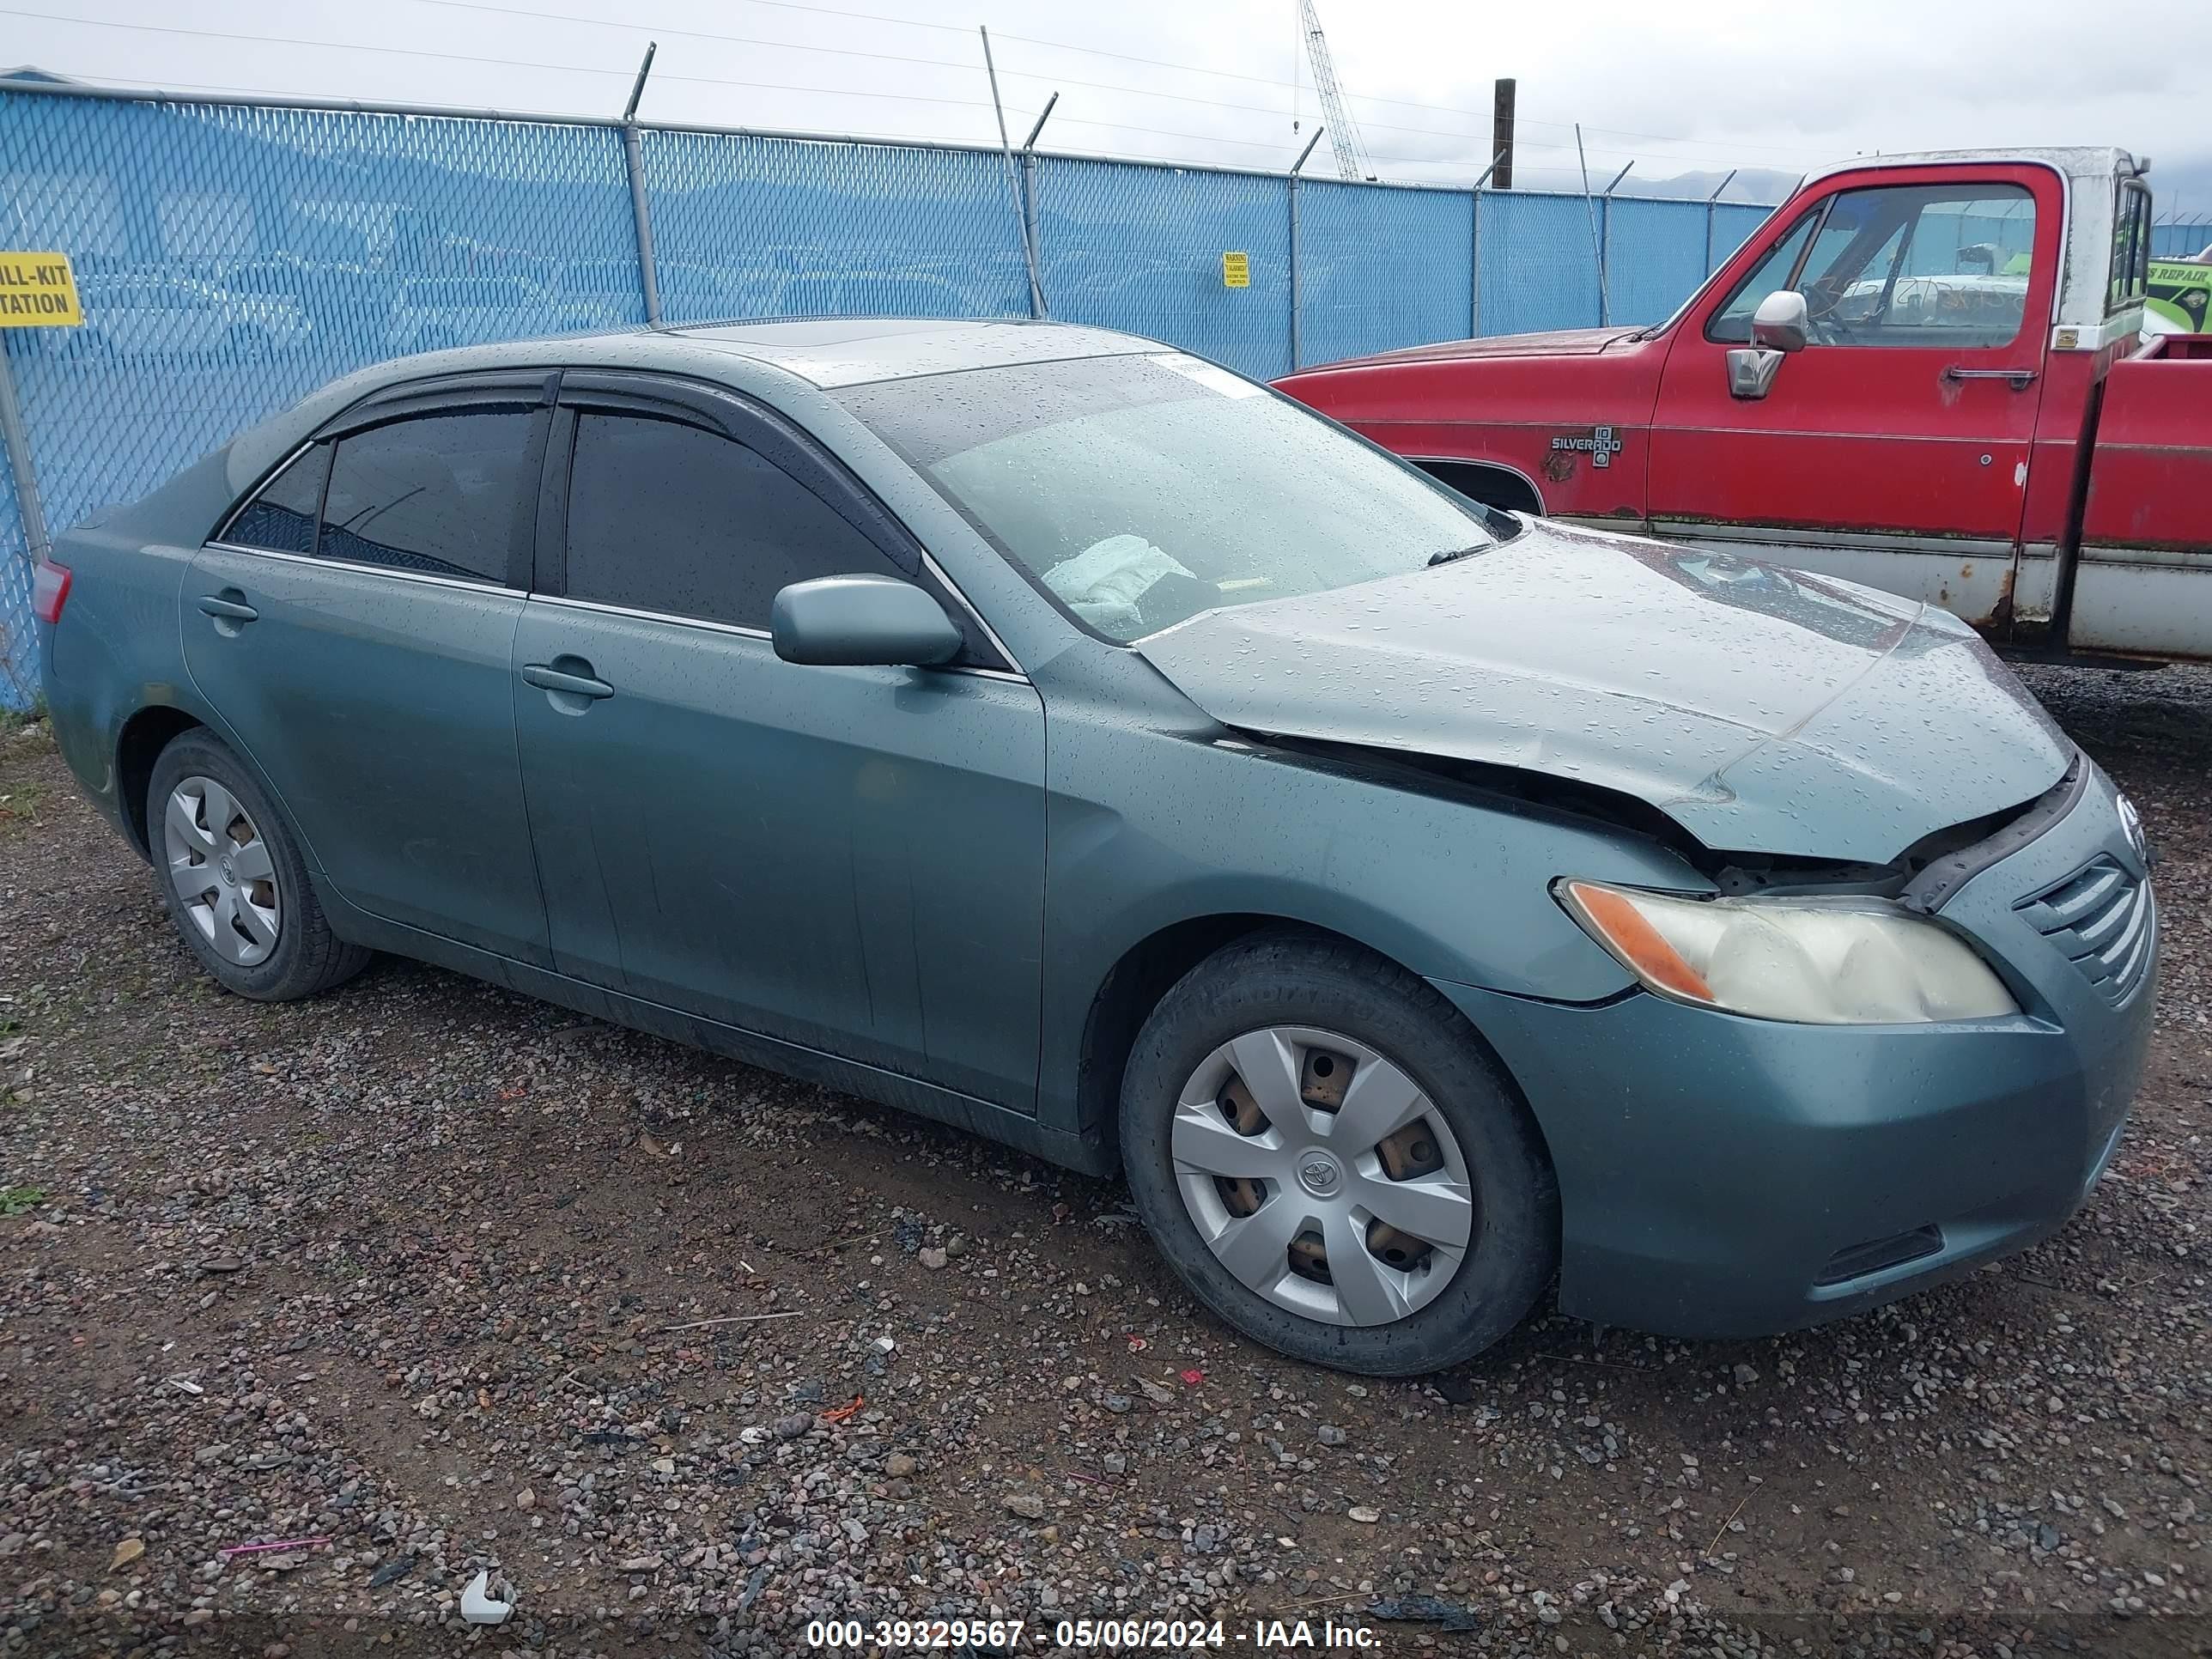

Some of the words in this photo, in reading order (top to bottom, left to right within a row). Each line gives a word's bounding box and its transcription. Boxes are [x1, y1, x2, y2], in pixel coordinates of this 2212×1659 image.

[2157, 269, 2209, 282] REPAIR
[0, 294, 69, 313] TATION
[1552, 438, 1621, 451] SILVERADO
